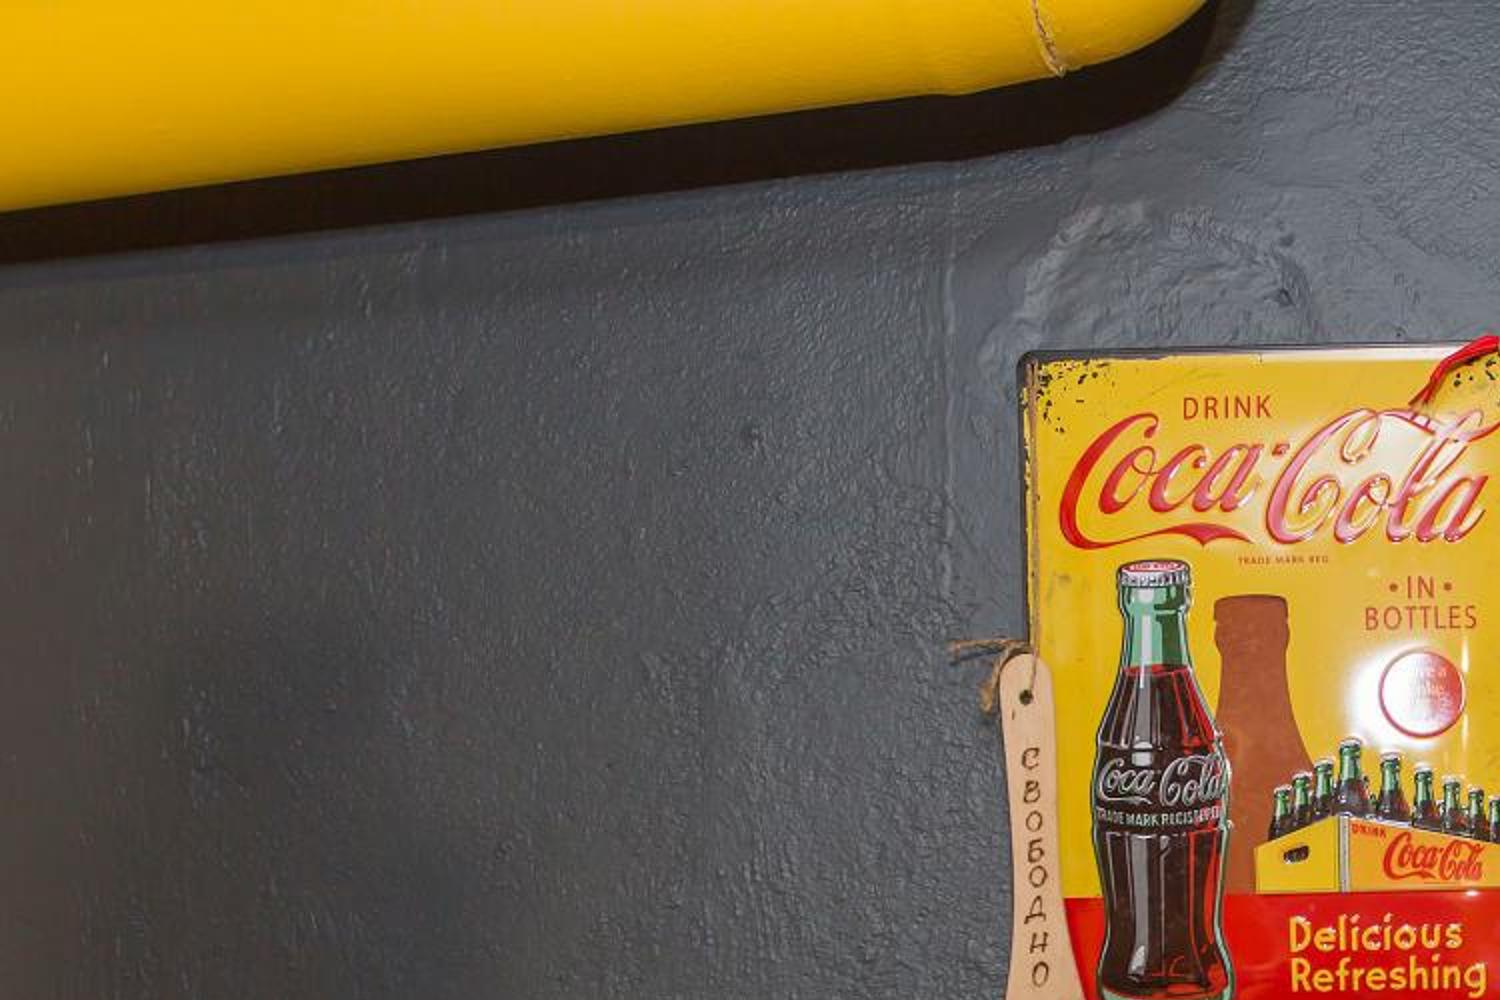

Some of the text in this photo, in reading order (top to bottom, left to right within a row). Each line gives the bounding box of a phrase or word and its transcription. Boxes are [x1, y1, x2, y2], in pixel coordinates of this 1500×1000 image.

[1183, 395, 1272, 419] DRINK
[1405, 576, 1436, 598] IN
[1364, 606, 1477, 631] BOTTLES
[1125, 812, 1160, 828] MARK
[1350, 822, 1387, 839] DRINK
[1382, 831, 1485, 881] Coca-Cola
[1288, 914, 1463, 952] Delicious
[1290, 953, 1488, 999] Refreshing
